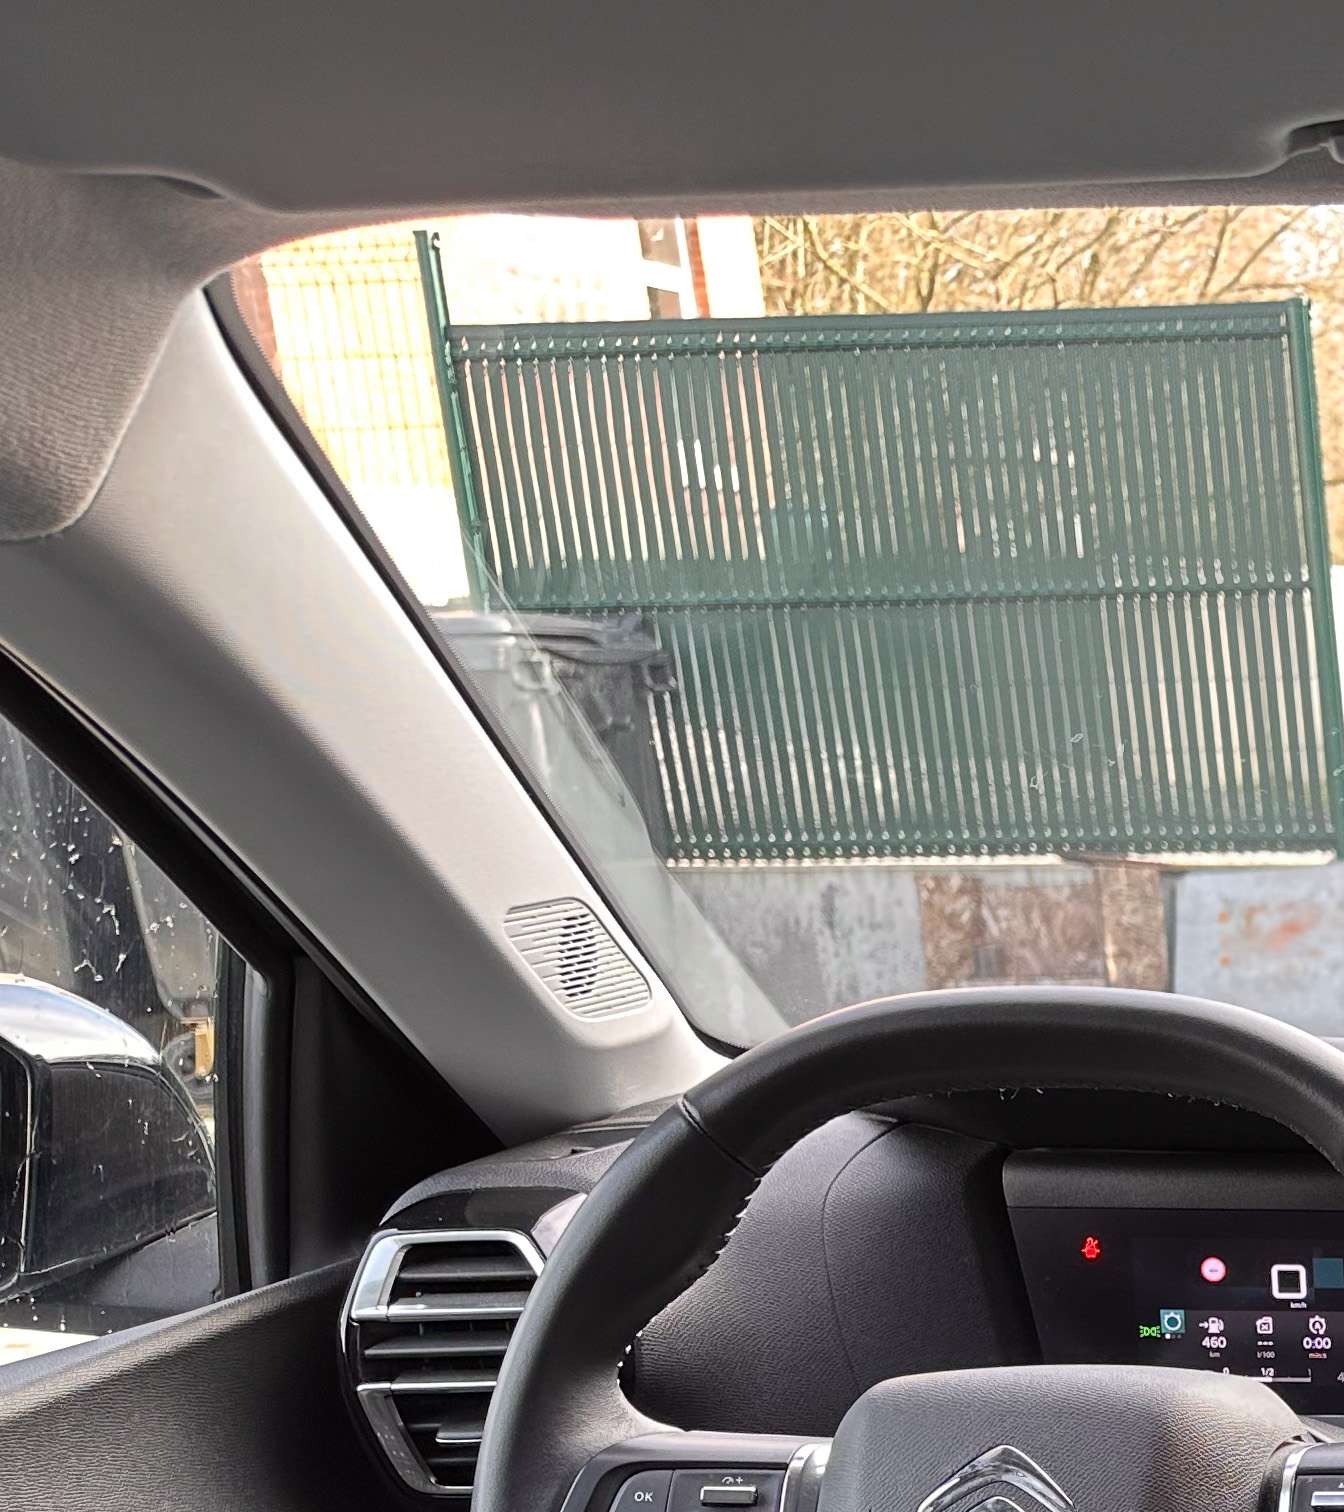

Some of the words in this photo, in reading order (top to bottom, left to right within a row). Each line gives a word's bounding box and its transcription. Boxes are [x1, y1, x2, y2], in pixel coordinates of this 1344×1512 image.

[1202, 1337, 1227, 1348] 460
[1303, 1337, 1331, 1349] 0:00
[1261, 1367, 1274, 1377] 1/2
[634, 1491, 653, 1502] OK
